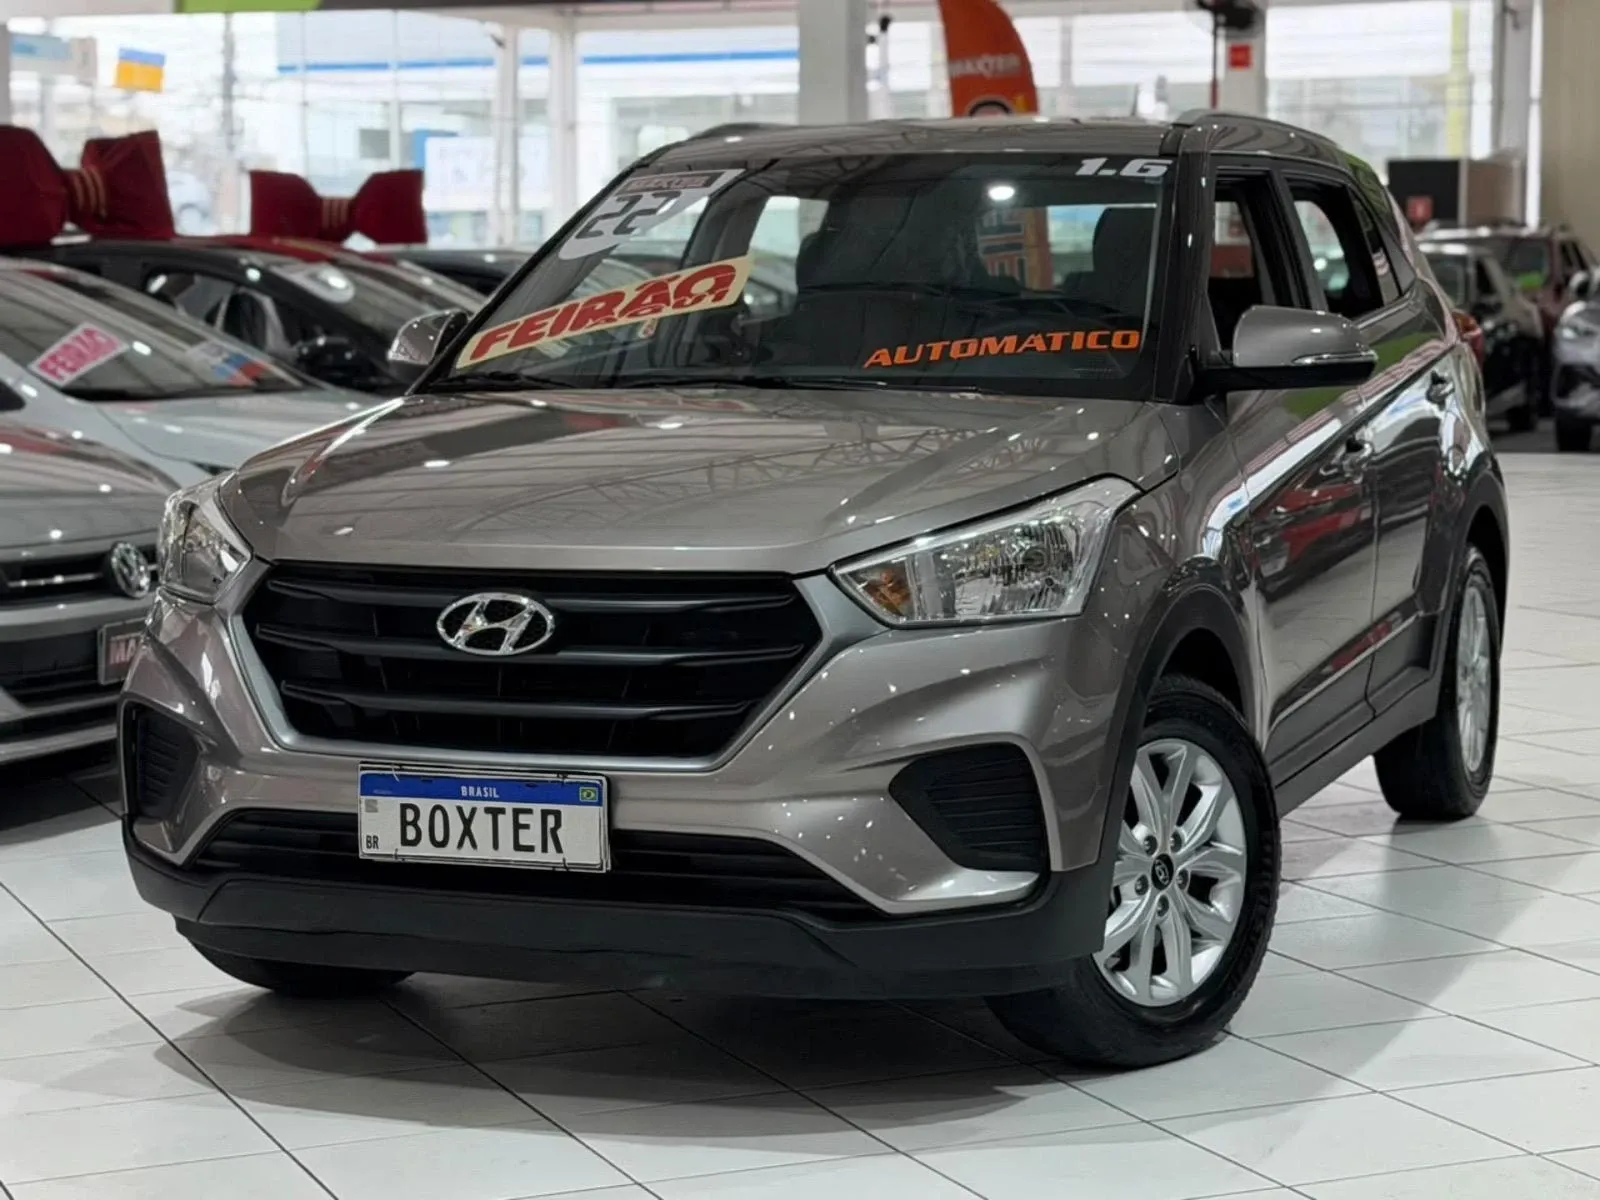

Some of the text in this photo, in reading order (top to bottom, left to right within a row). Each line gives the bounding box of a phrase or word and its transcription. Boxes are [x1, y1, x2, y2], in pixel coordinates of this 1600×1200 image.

[1074, 157, 1173, 177] 1.6
[575, 190, 682, 240] 22
[469, 264, 737, 361] FEIRÃO
[460, 785, 500, 799] BRASIL
[365, 834, 379, 850] BR
[399, 802, 564, 854] BOXTER
